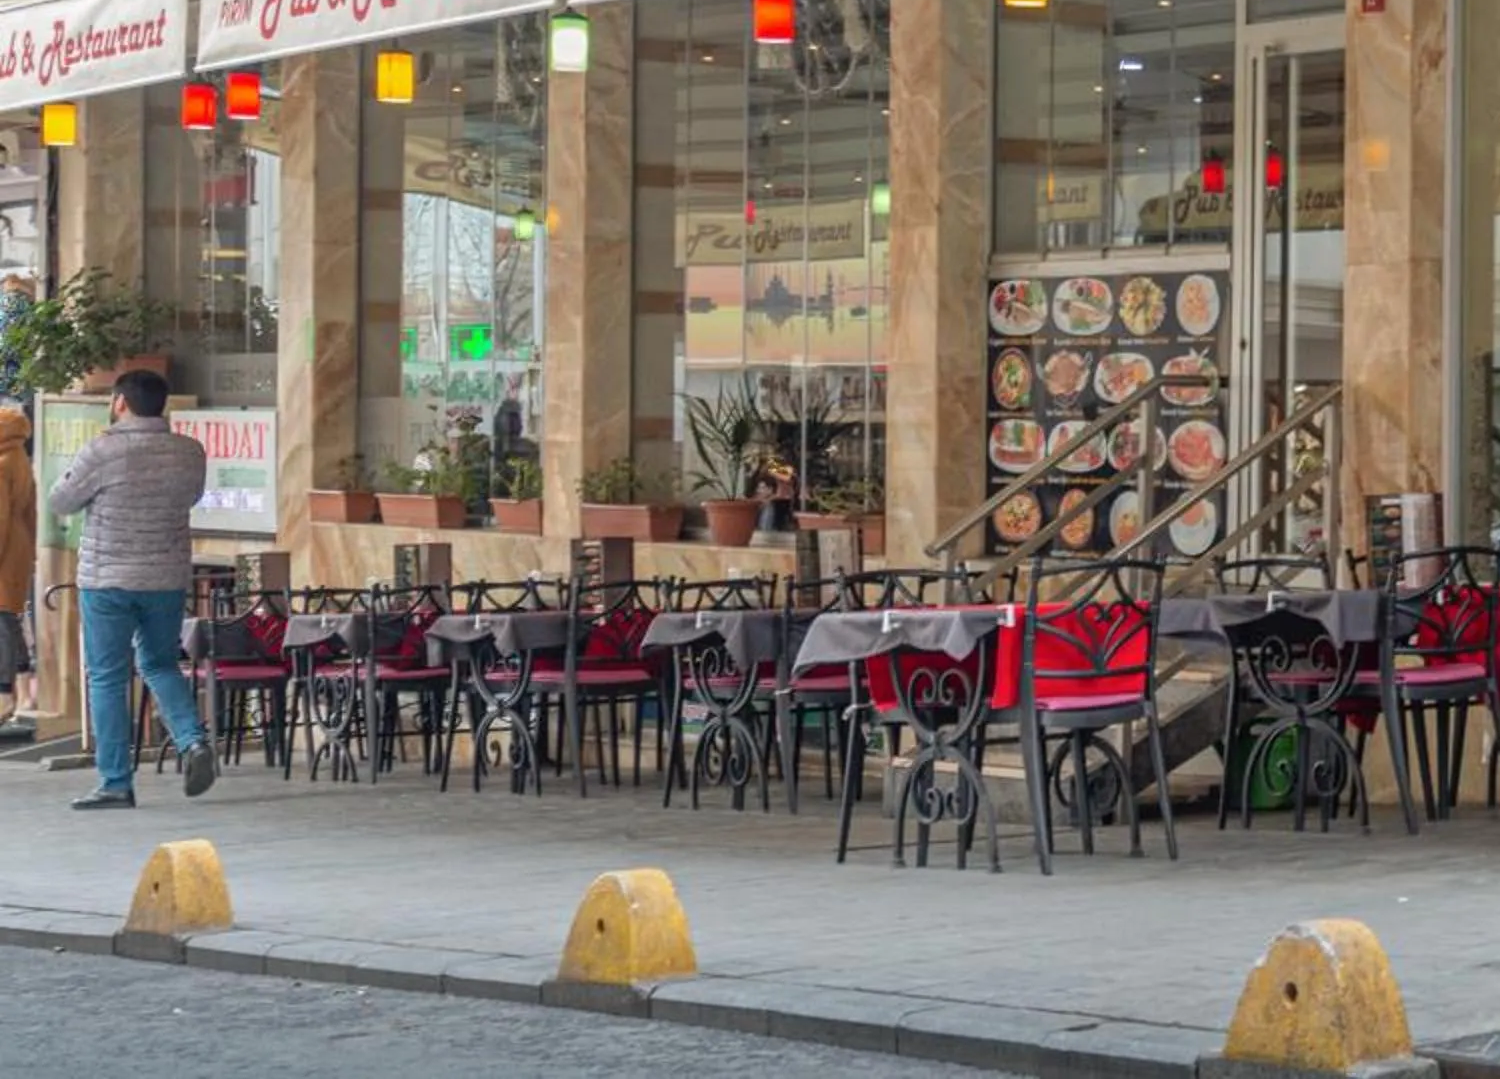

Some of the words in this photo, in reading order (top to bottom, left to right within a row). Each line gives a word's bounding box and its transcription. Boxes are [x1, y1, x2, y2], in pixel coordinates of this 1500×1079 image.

[0, 30, 17, 80] ub
[21, 30, 35, 75] &
[38, 8, 168, 87] Restaurant
